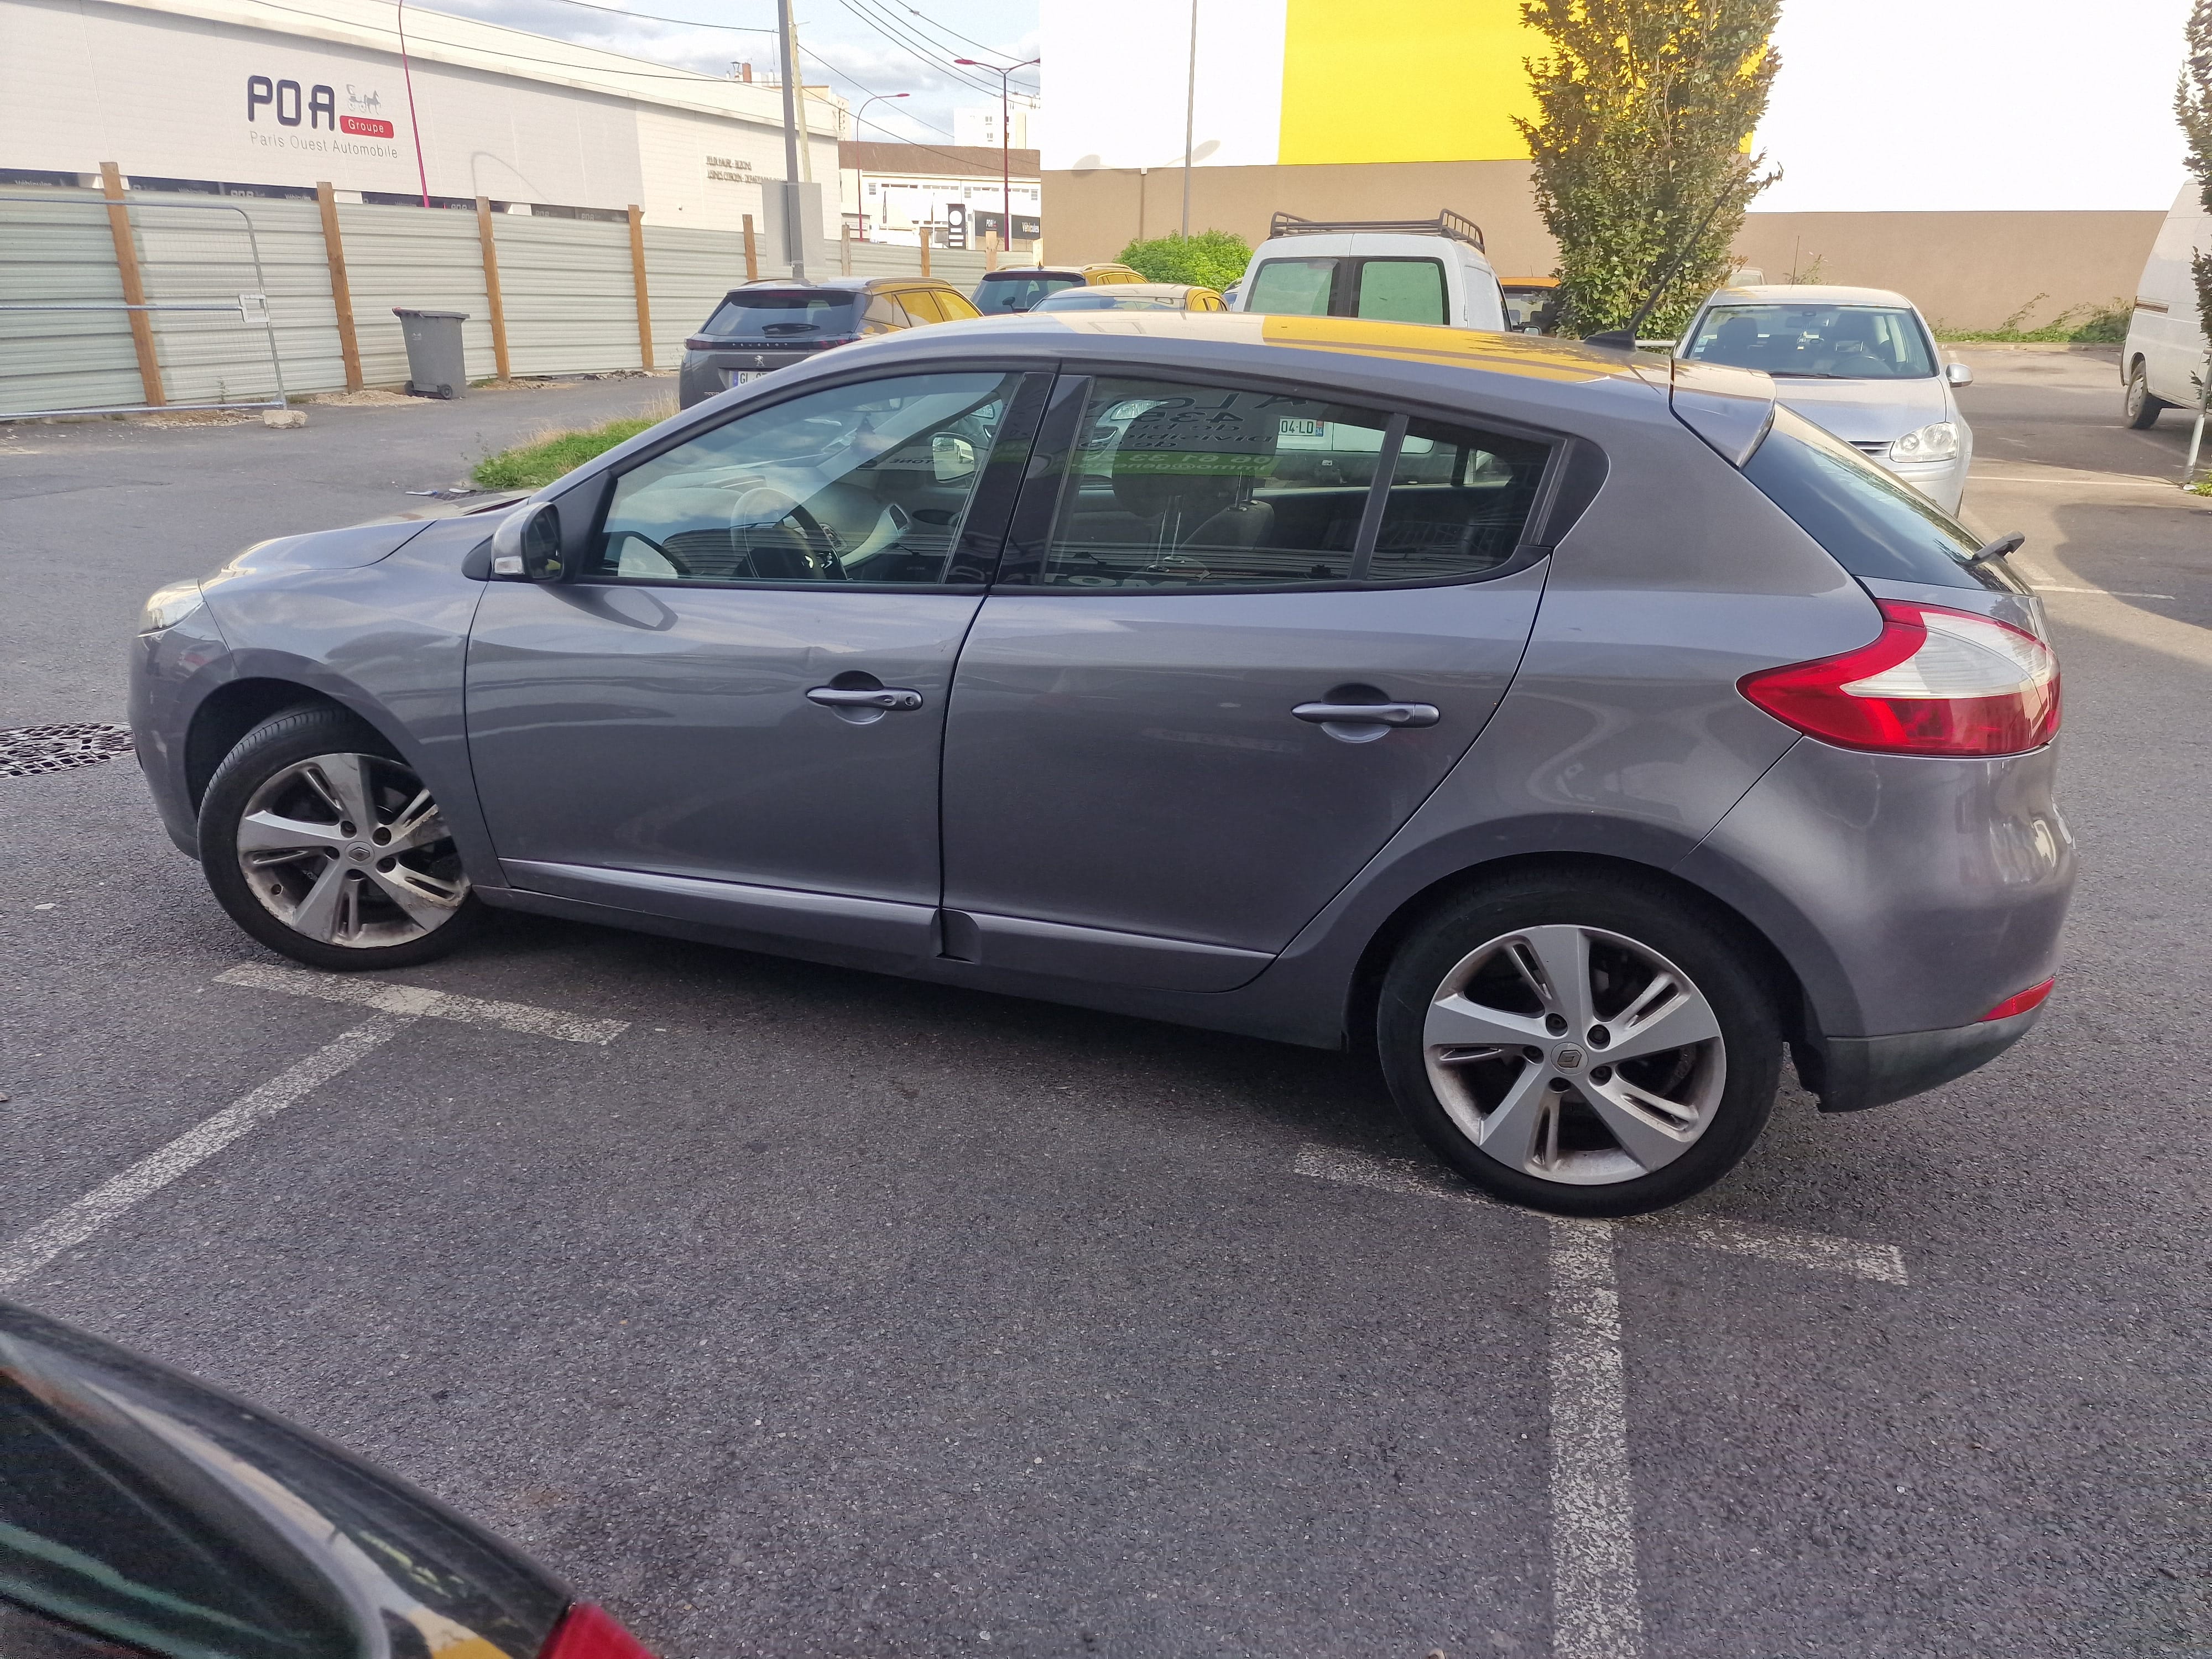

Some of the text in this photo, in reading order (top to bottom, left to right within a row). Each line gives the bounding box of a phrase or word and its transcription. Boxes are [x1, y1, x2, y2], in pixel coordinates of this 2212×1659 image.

[248, 75, 335, 132] POA
[348, 118, 384, 134] Groupe
[249, 131, 398, 159] Paris Ouest Automobile
